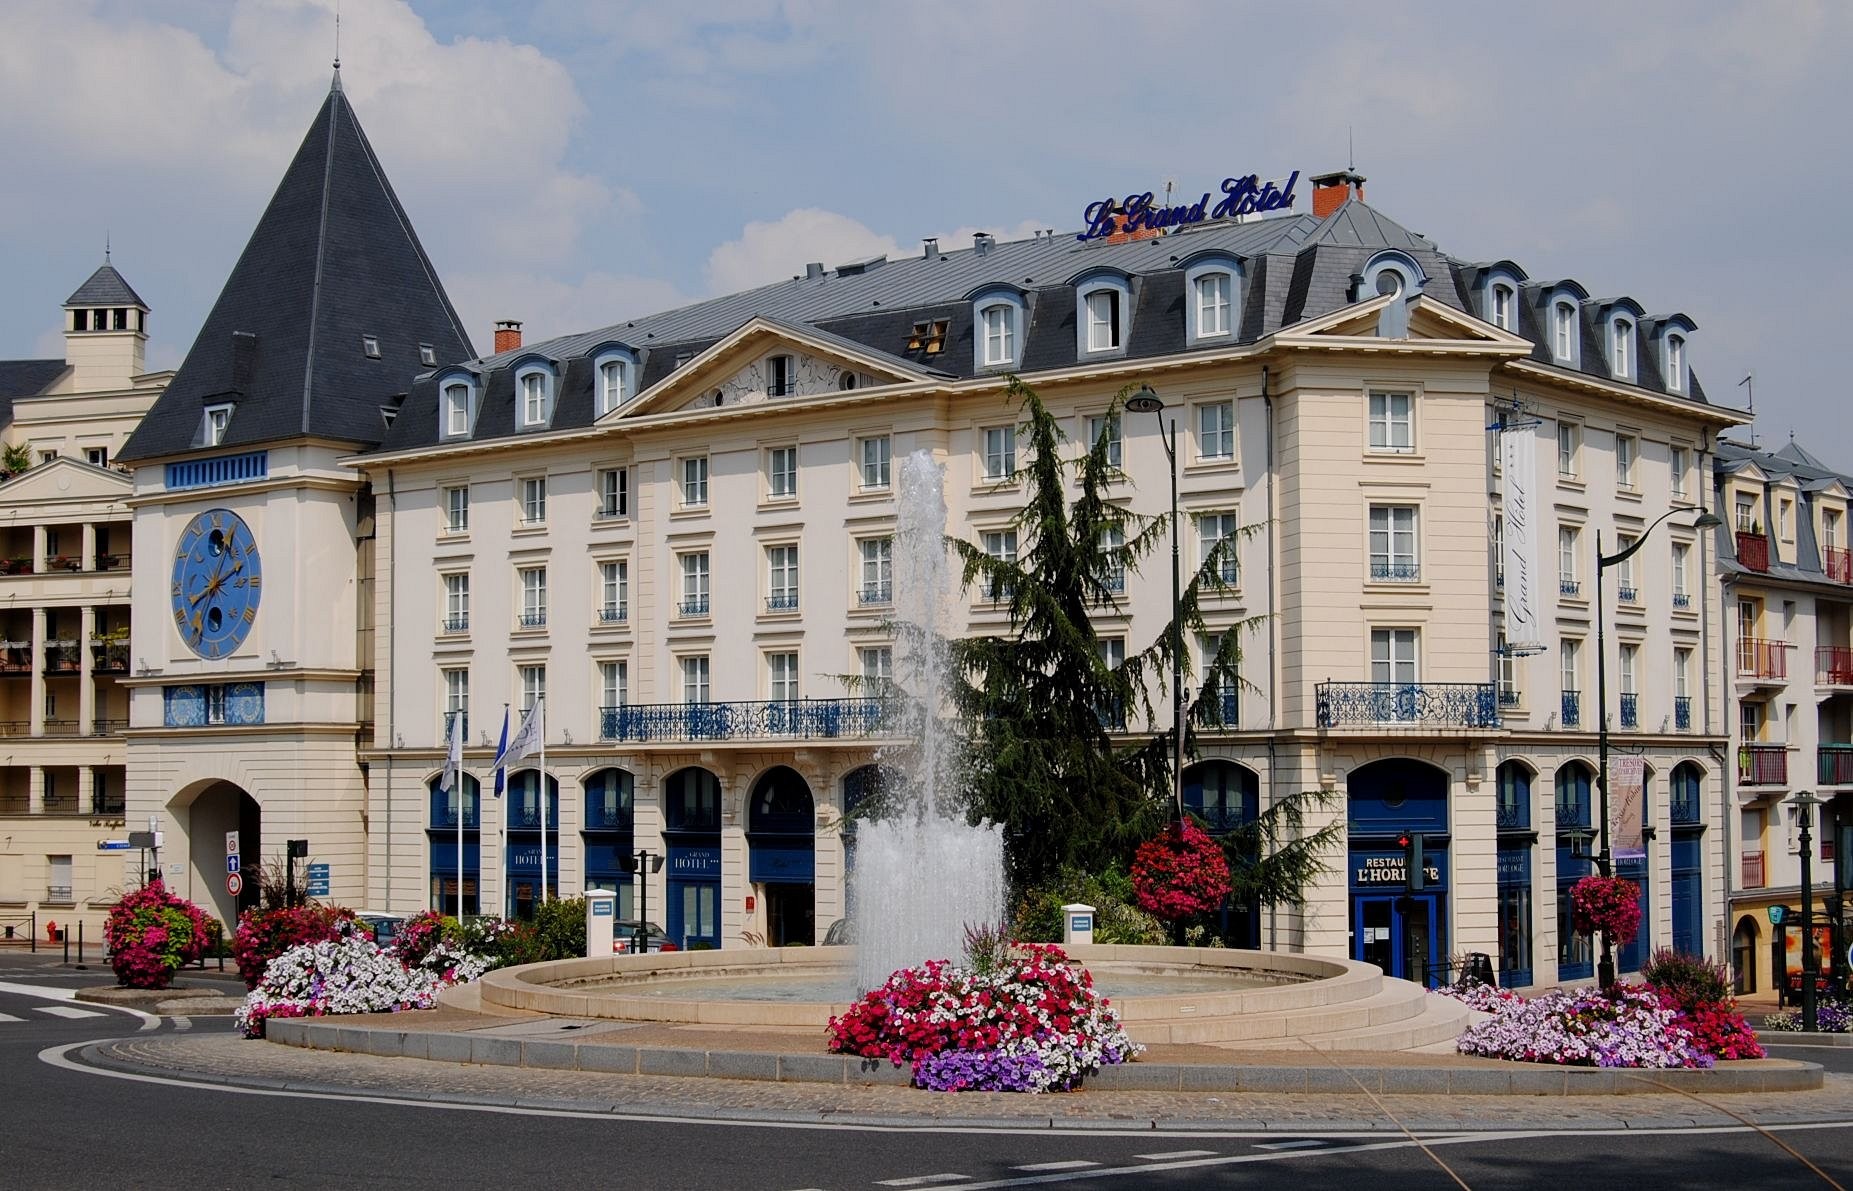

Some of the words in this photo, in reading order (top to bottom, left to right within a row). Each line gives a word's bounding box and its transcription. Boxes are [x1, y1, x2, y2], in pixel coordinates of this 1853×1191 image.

[1076, 197, 1115, 241] Le
[1122, 192, 1211, 234] Grand
[1506, 474, 1526, 545] Hôtel
[1508, 547, 1537, 632] Grand
